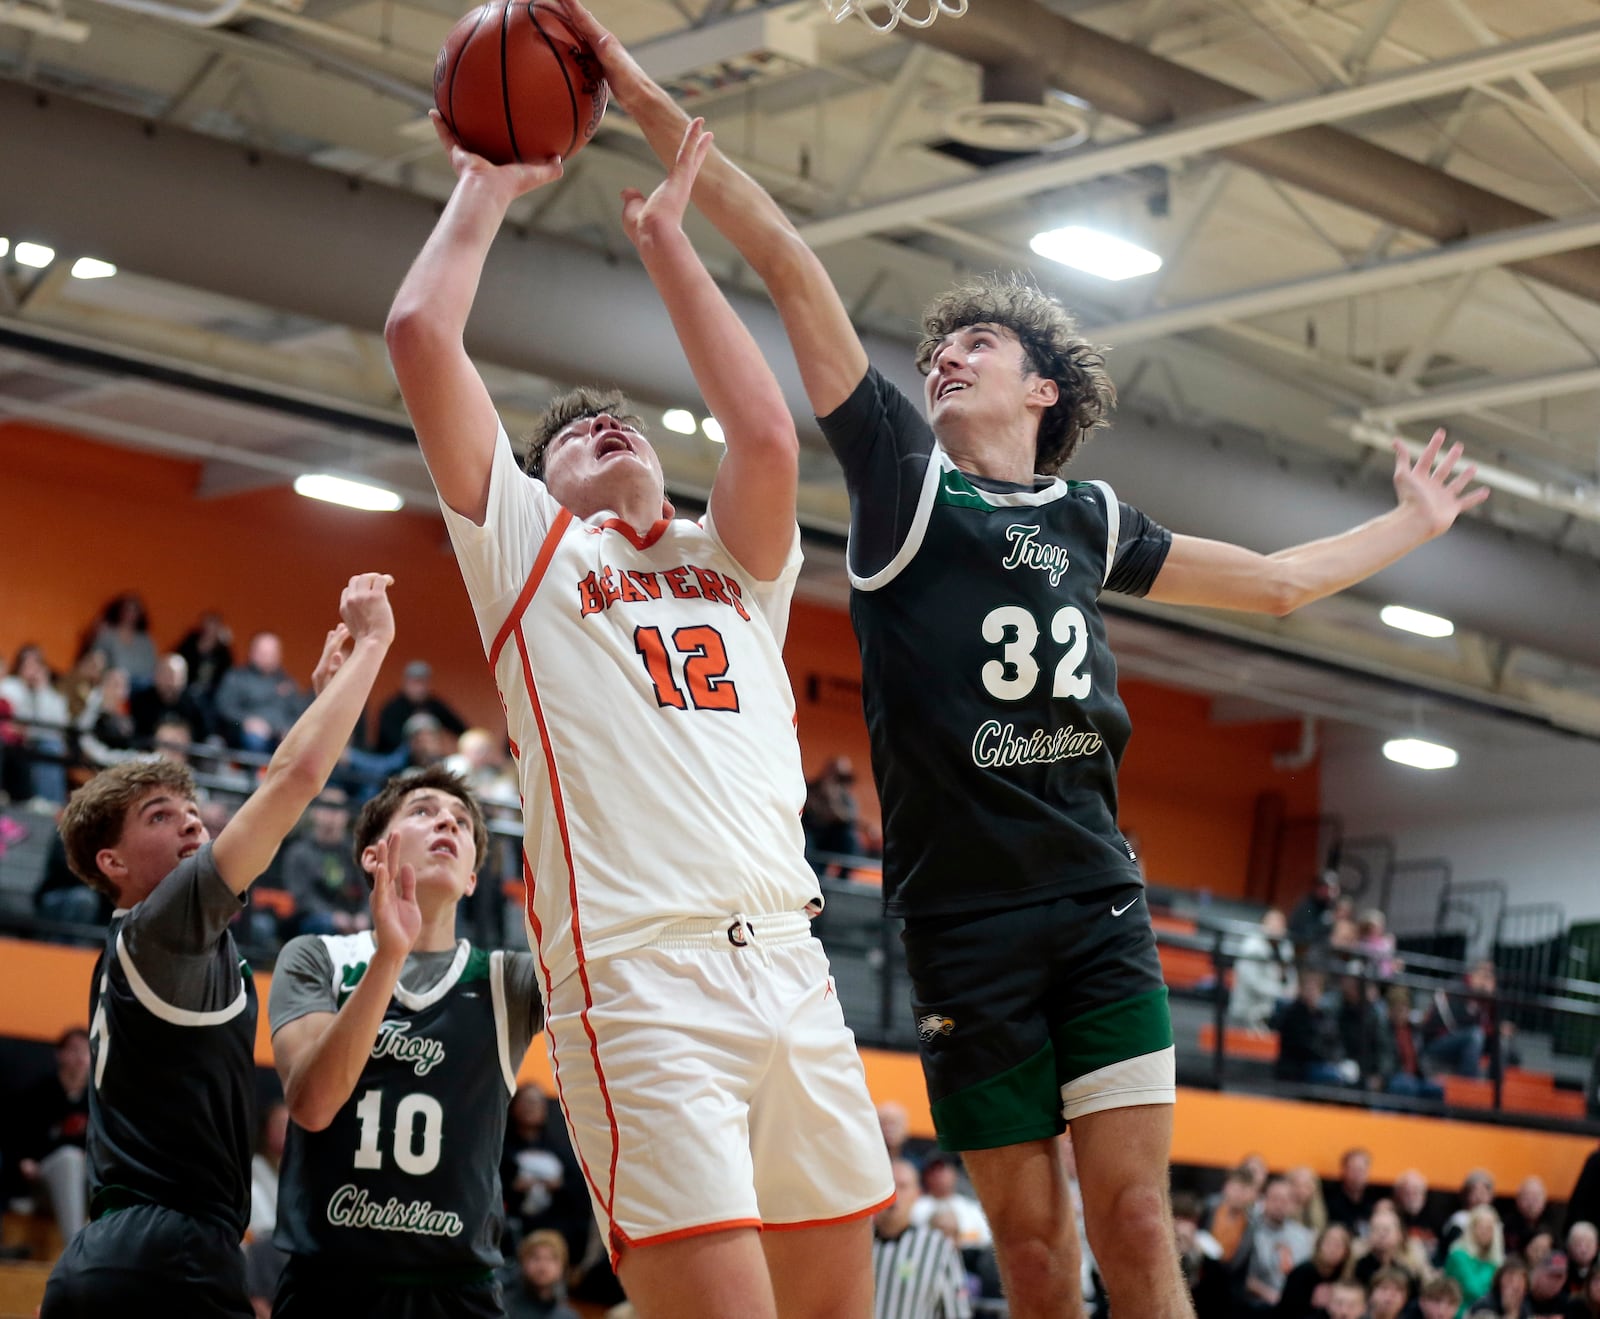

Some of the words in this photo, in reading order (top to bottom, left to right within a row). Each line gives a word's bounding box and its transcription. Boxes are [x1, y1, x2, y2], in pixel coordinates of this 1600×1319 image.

[1002, 523, 1069, 587] Troy
[577, 564, 752, 622] BEAVERS
[633, 624, 741, 714] 12
[981, 605, 1092, 701] 32
[971, 719, 1103, 768] Christian
[371, 1020, 445, 1076] Troy
[353, 1089, 444, 1176] 10
[326, 1183, 463, 1237] Christian
